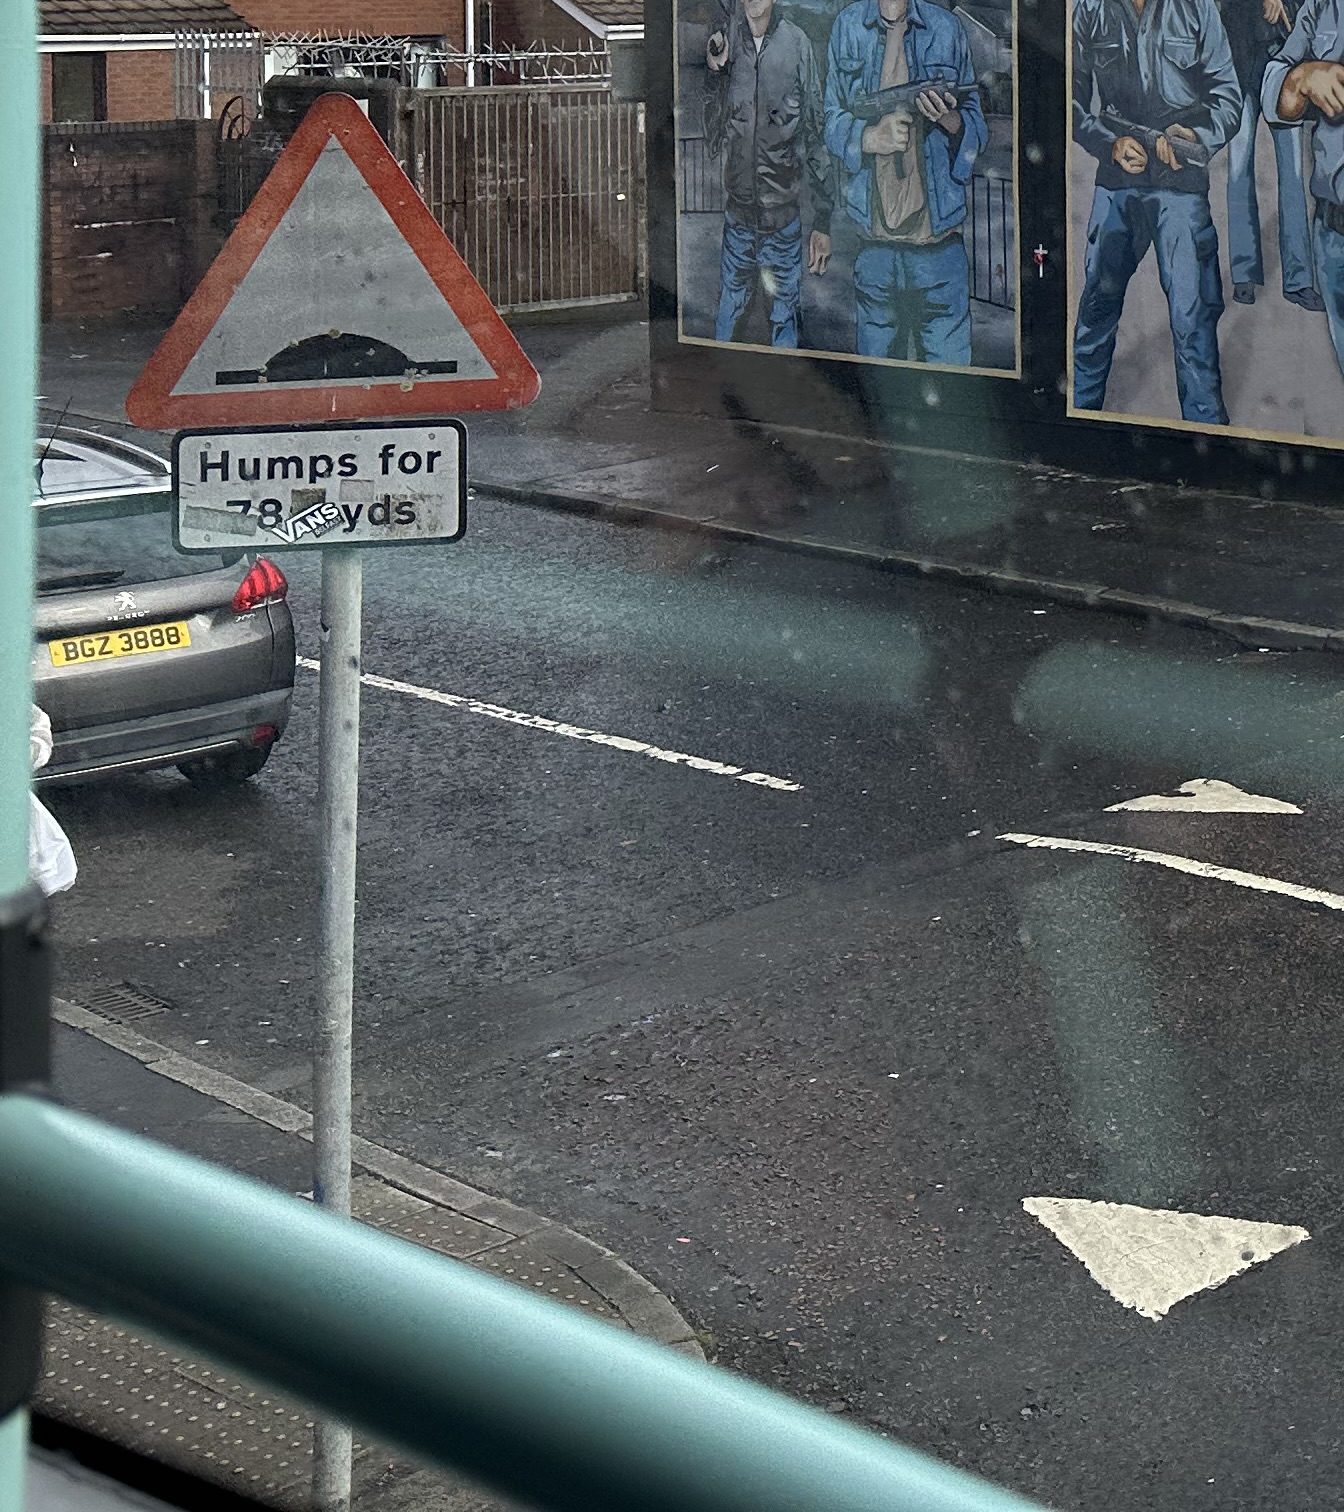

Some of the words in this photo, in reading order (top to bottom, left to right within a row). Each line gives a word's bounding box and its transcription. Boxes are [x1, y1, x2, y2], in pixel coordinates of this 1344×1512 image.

[200, 451, 358, 484] Humps
[379, 444, 441, 476] for
[271, 502, 339, 543] VANS
[341, 494, 417, 533] yds
[62, 634, 113, 662] BGZ
[118, 626, 182, 652] 3888
